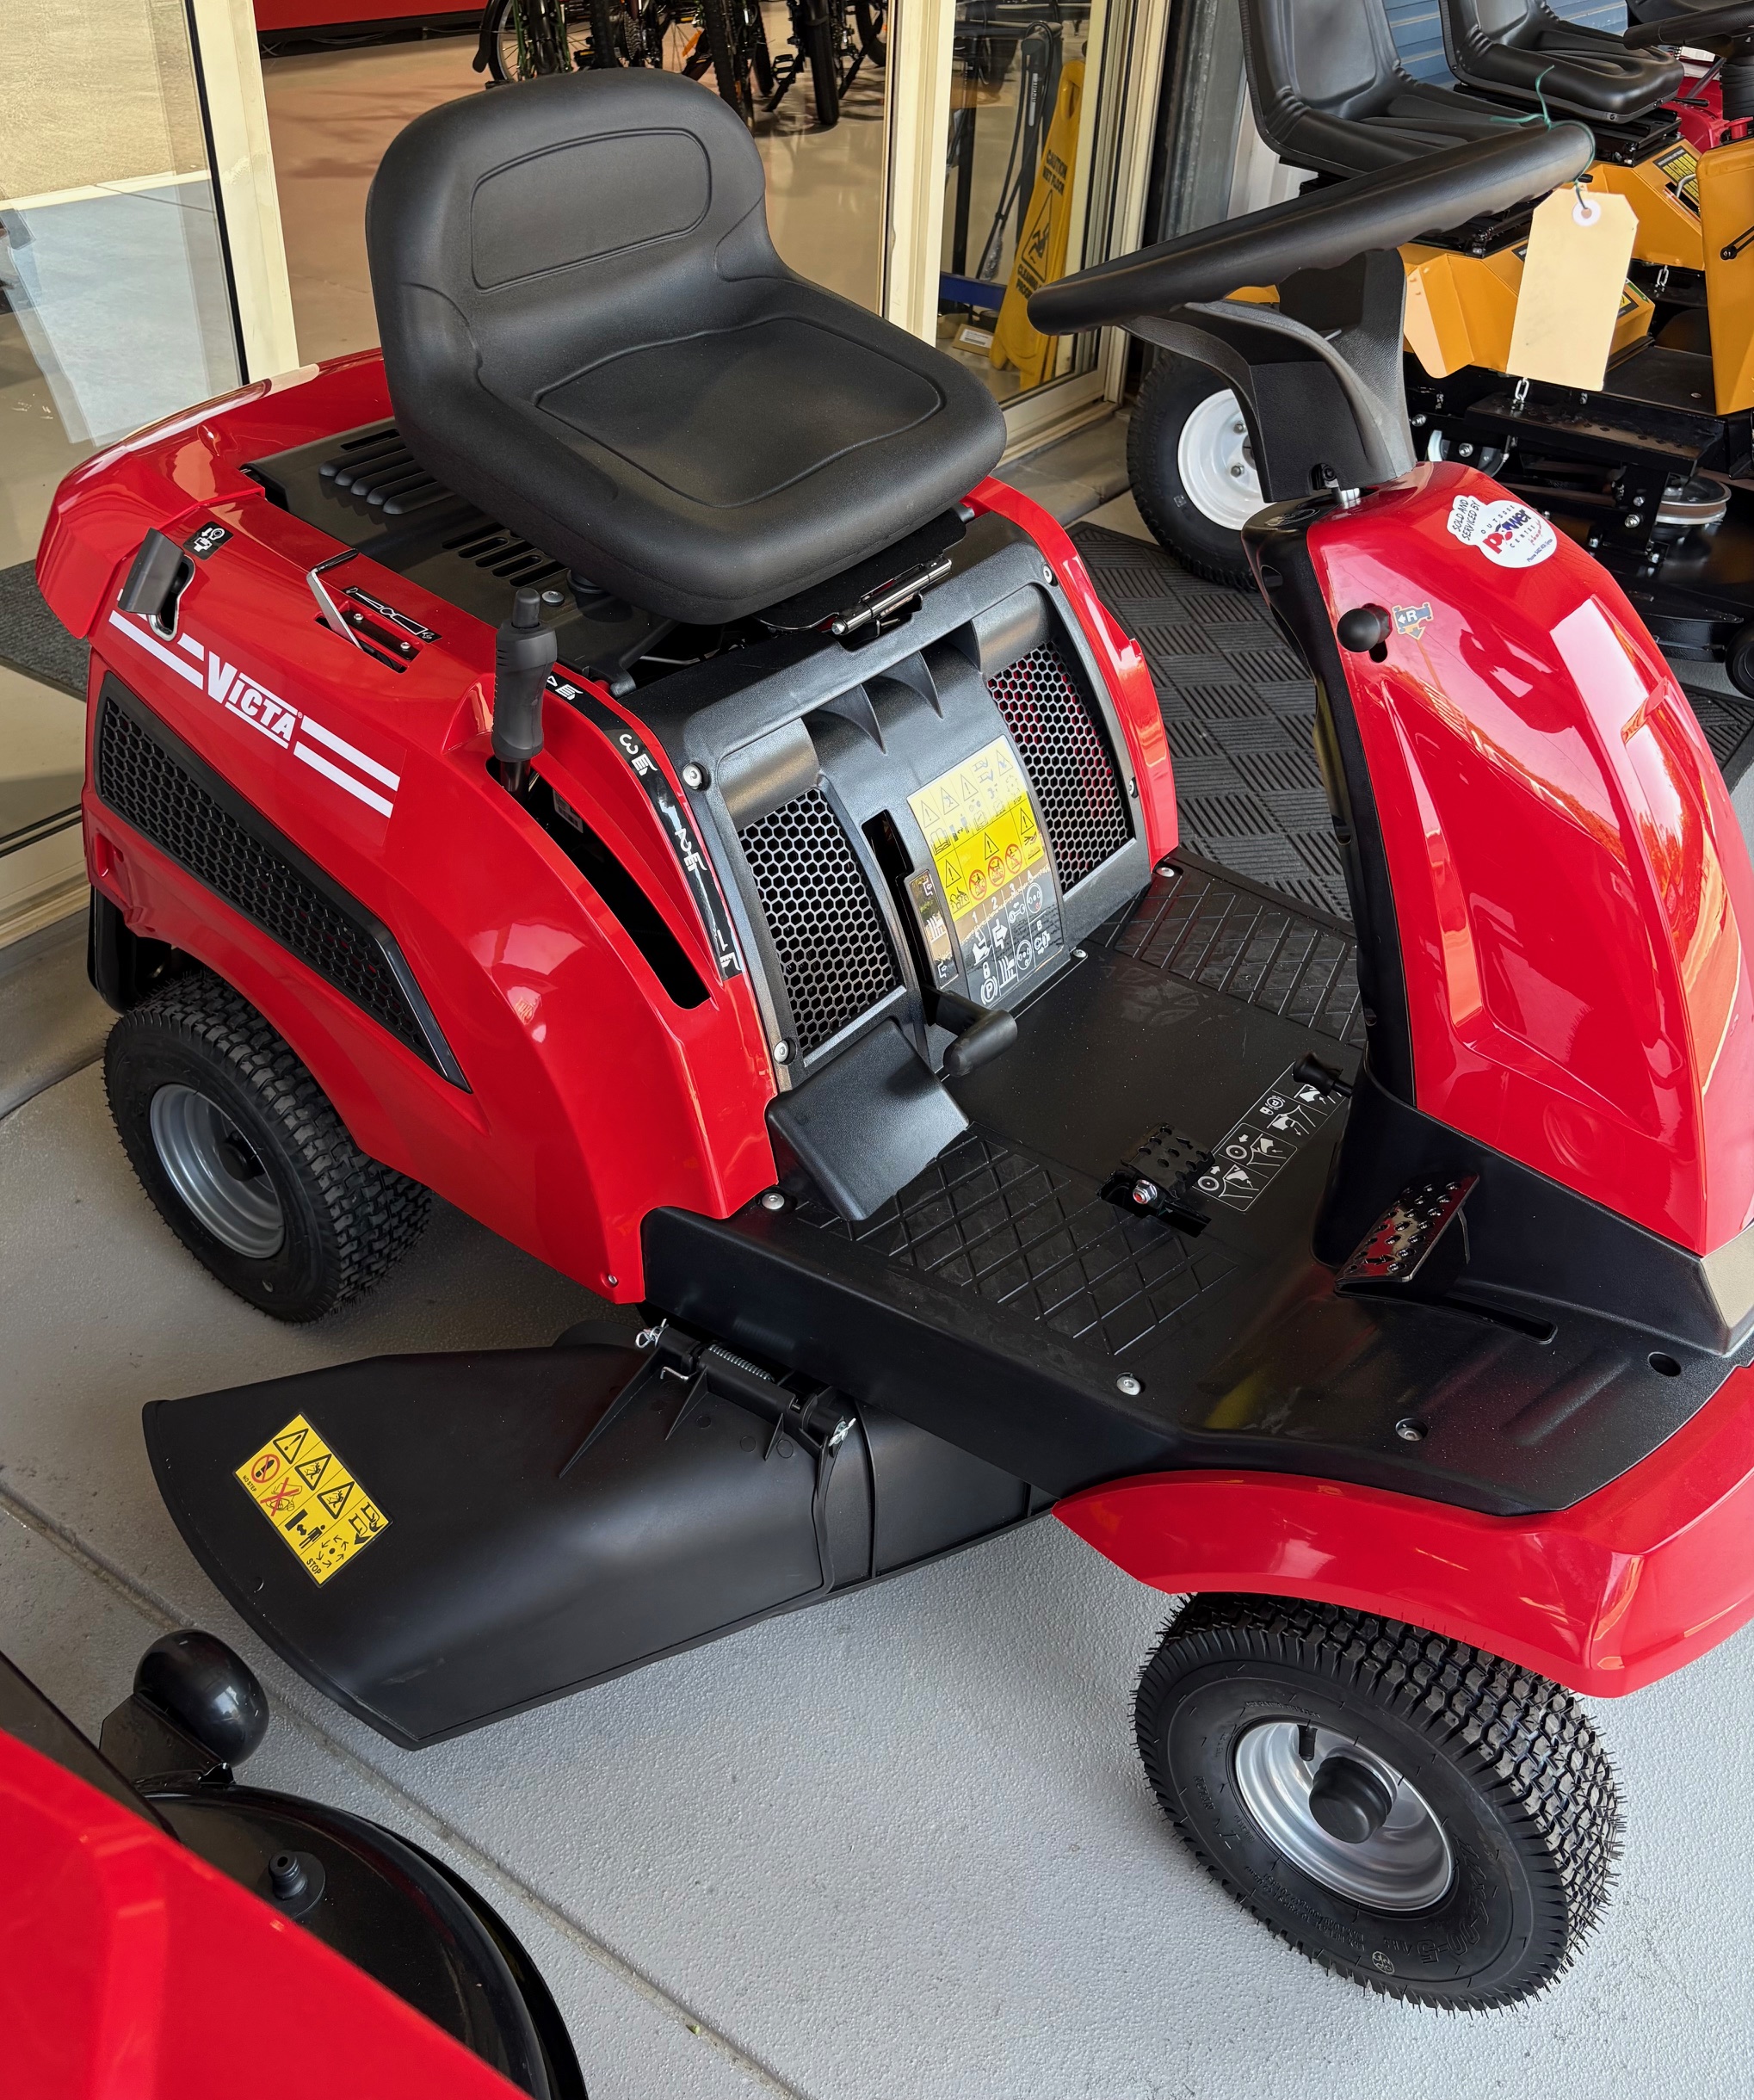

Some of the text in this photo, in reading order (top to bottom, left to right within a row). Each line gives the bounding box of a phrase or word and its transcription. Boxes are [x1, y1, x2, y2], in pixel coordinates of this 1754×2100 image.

[1452, 498, 1469, 532] SOLD AND
[1461, 499, 1481, 541] SERVICED BY
[1406, 610, 1417, 622] R
[207, 650, 297, 742] VICTA
[619, 733, 639, 755] 3
[675, 828, 692, 852] 2
[972, 911, 979, 923] 1
[991, 896, 997, 910] 2
[1009, 882, 1016, 896] 3
[717, 929, 729, 951] 1
[247, 1480, 257, 1492] STEP
[306, 1558, 322, 1574] STOP
